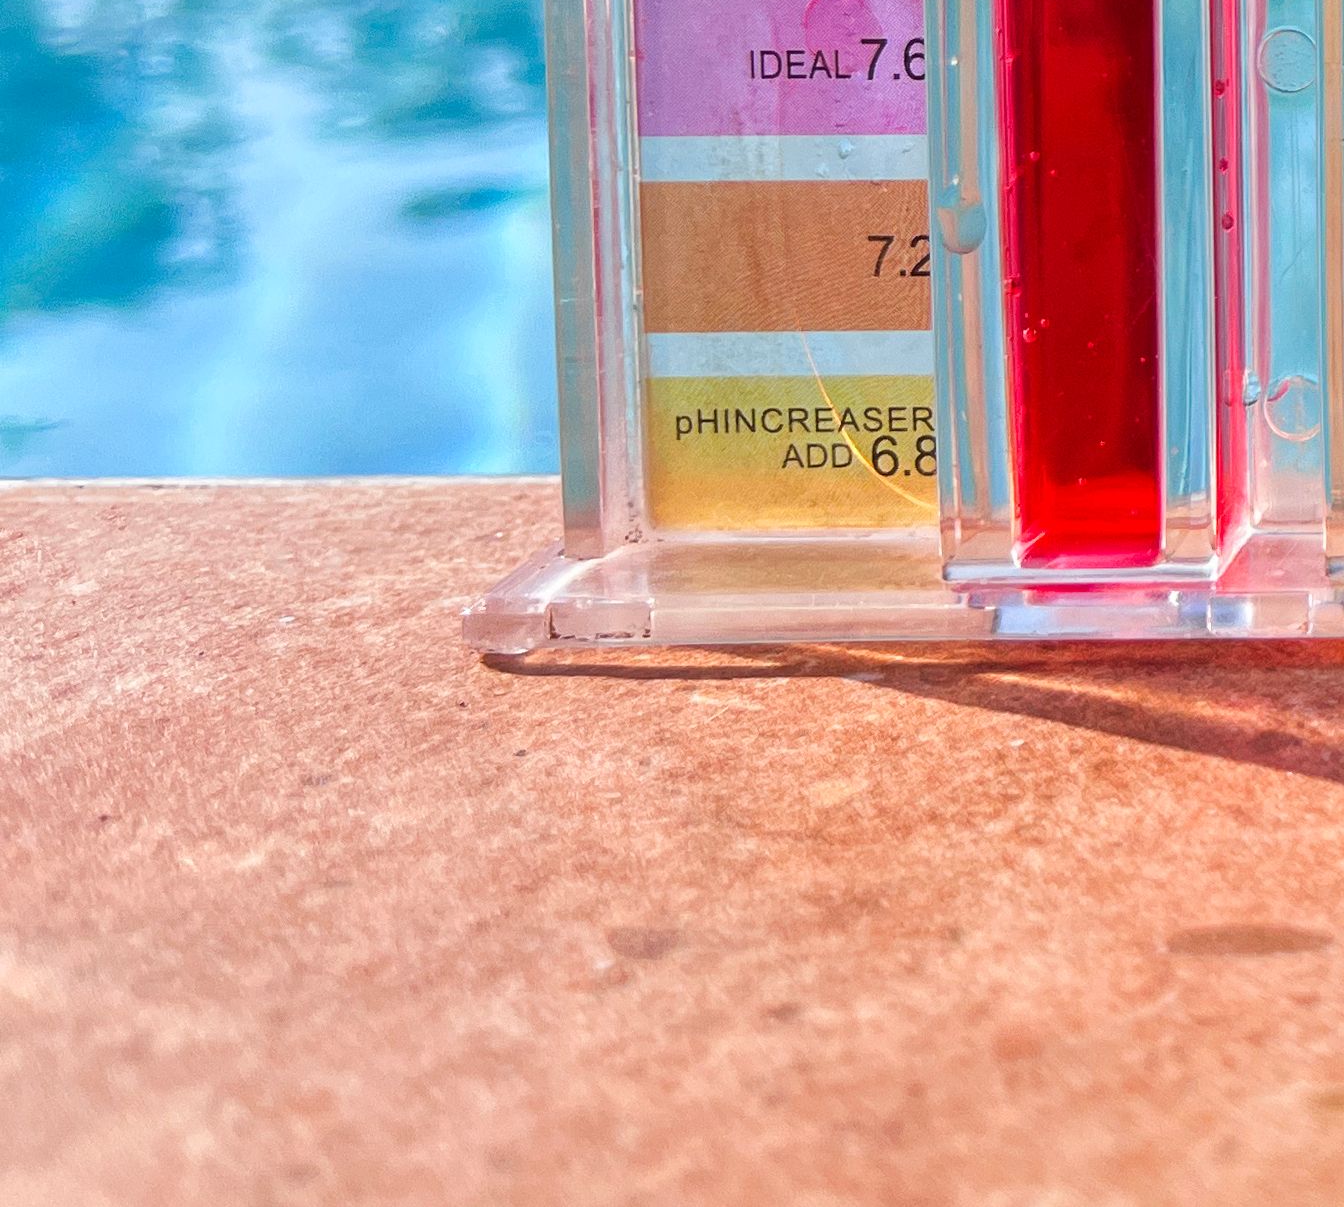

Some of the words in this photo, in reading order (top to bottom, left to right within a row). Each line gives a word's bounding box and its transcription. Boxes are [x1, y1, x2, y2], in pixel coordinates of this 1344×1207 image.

[750, 50, 851, 79] IDEAL
[860, 38, 925, 81] 7.6
[867, 234, 930, 277] 7.2
[675, 406, 934, 440] pHINCREASER
[781, 443, 852, 470] ADD
[871, 434, 937, 477] 6.8
